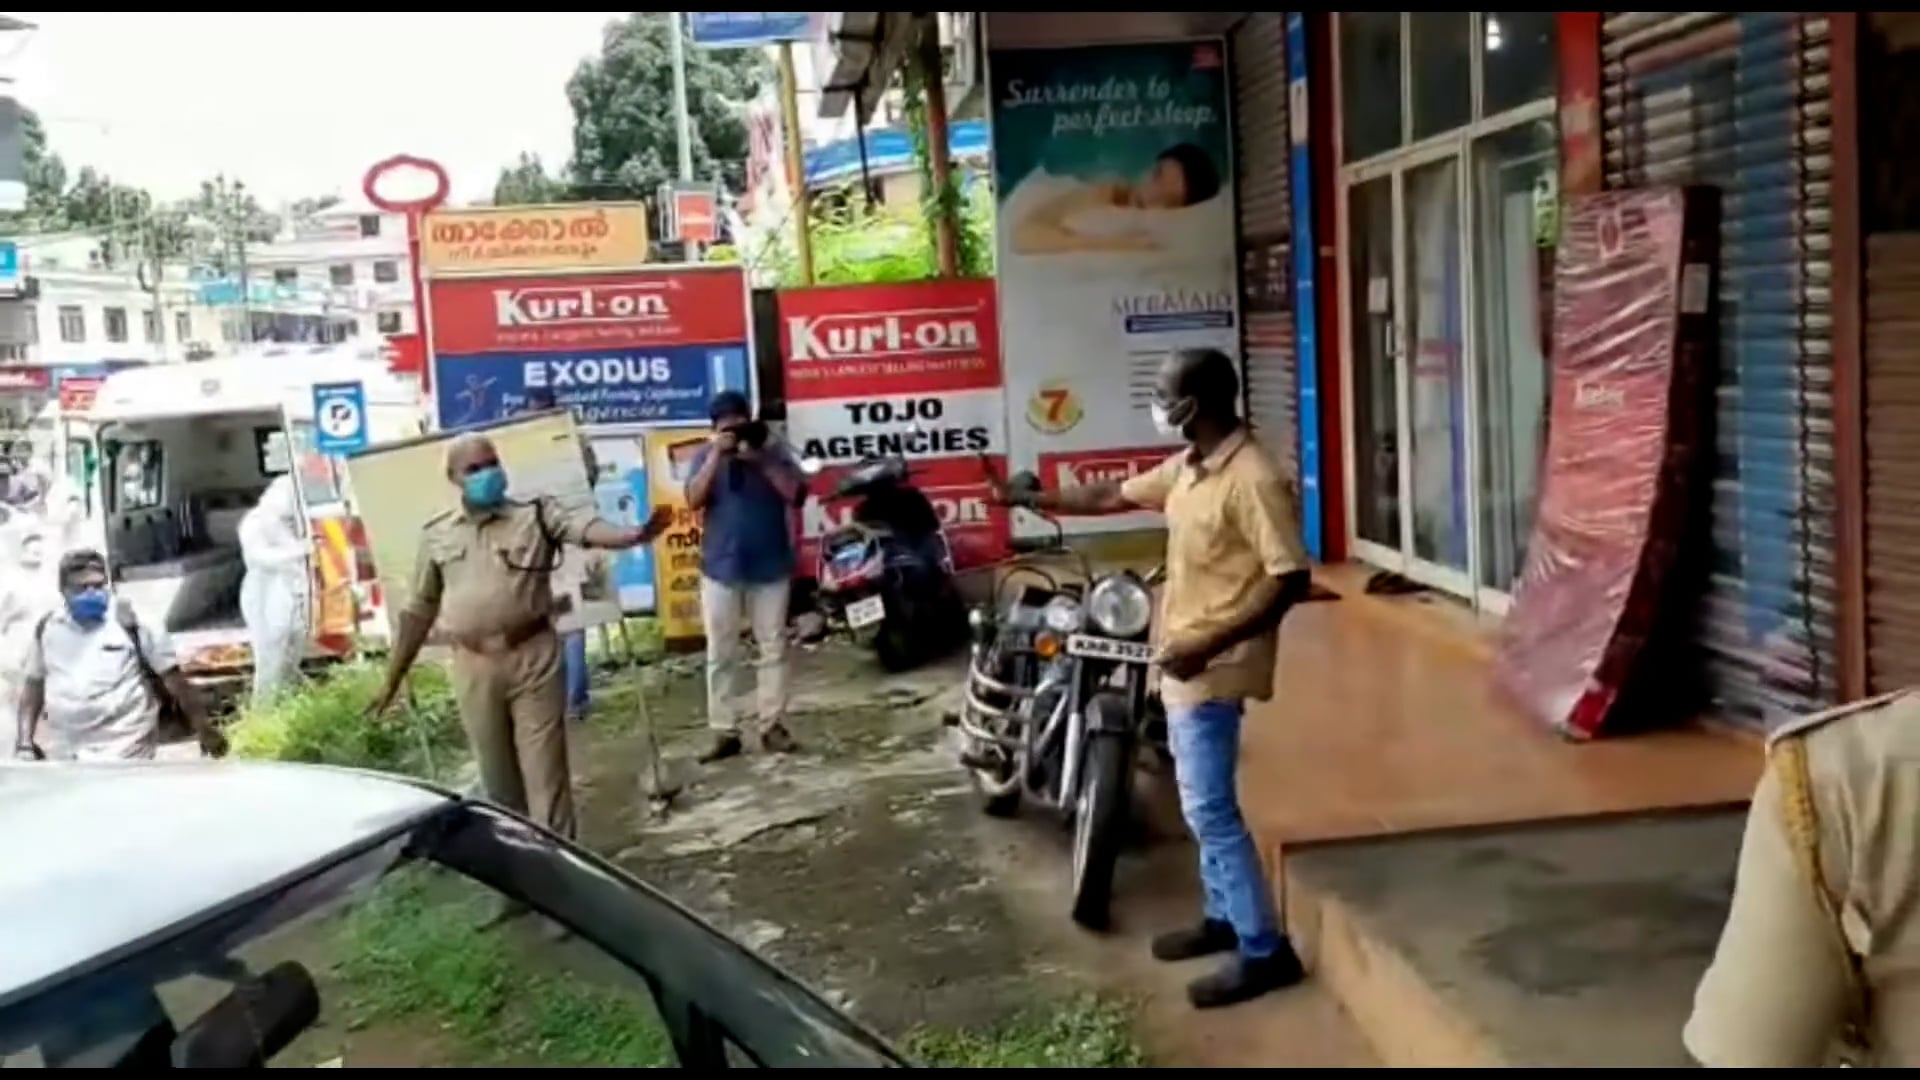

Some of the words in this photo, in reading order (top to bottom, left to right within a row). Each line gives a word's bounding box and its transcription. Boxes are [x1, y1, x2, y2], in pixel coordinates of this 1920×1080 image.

[1001, 75, 1138, 108] Surrender
[1147, 74, 1171, 100] to
[1052, 101, 1143, 138] perfect
[493, 288, 670, 326] Kurl-on
[787, 315, 978, 361] Kurl-on
[524, 357, 671, 387] EXODUS
[845, 398, 943, 424] TOJO
[1039, 389, 1068, 421] 7
[802, 427, 989, 461] AGENCIES
